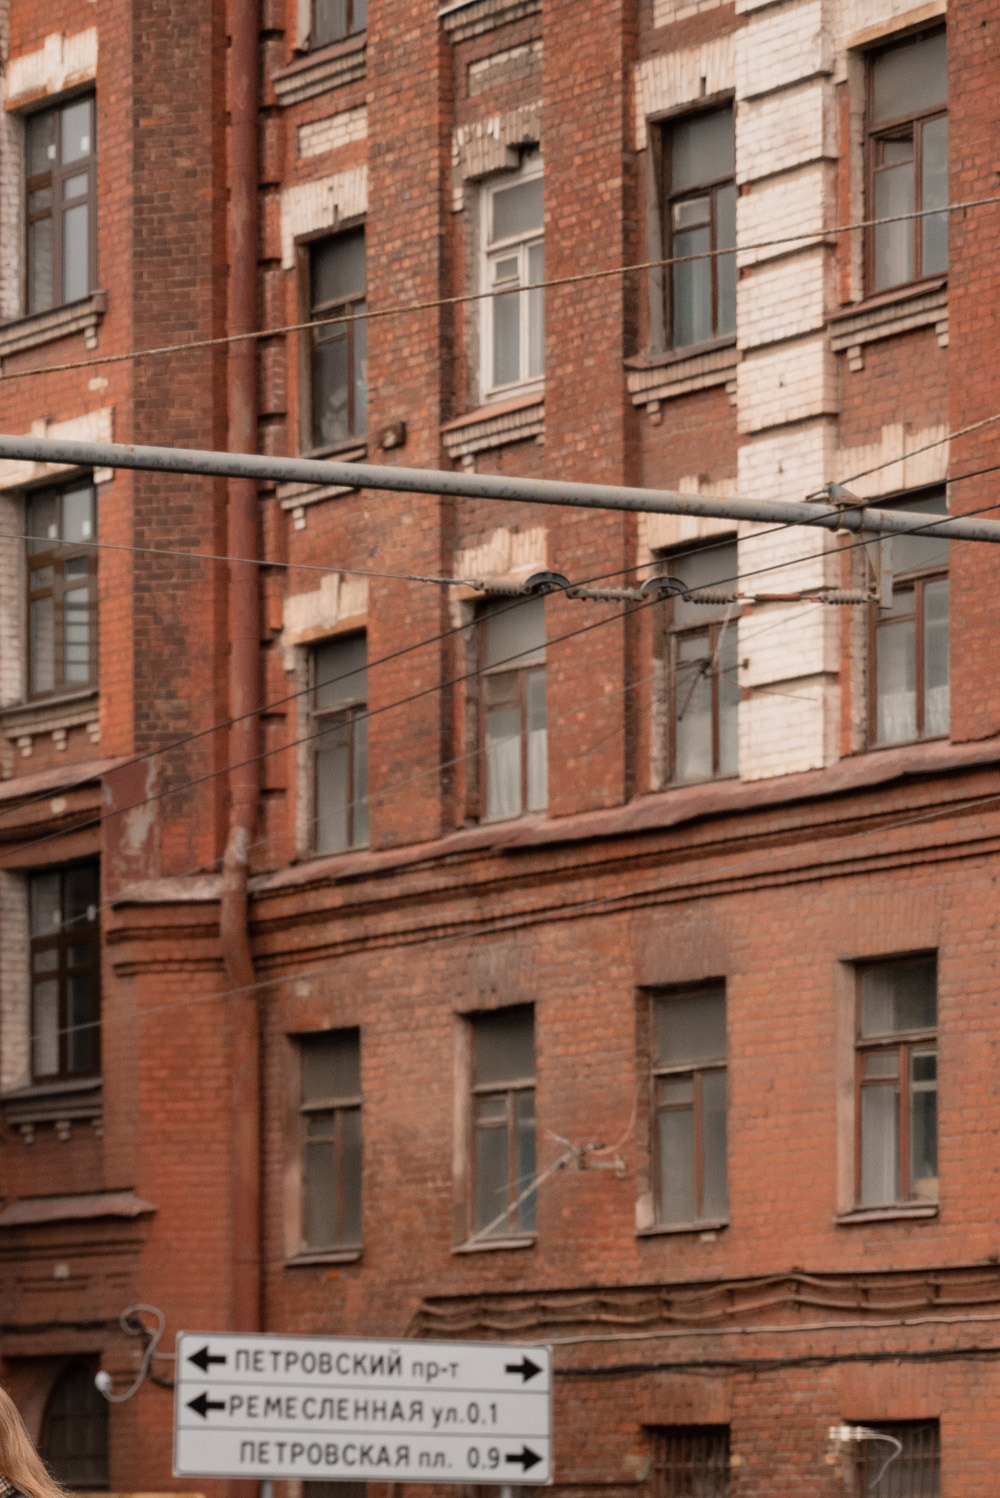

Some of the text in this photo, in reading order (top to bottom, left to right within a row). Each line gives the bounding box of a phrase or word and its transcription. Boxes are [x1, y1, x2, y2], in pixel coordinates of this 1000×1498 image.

[235, 1348, 459, 1382] ПЕТРОВСКИЙ пр-т
[229, 1395, 424, 1422] РЕМЕСЛЕННАЯ
[240, 1440, 500, 1469] ПЕТРОВСКАЯ пл. 0.9
